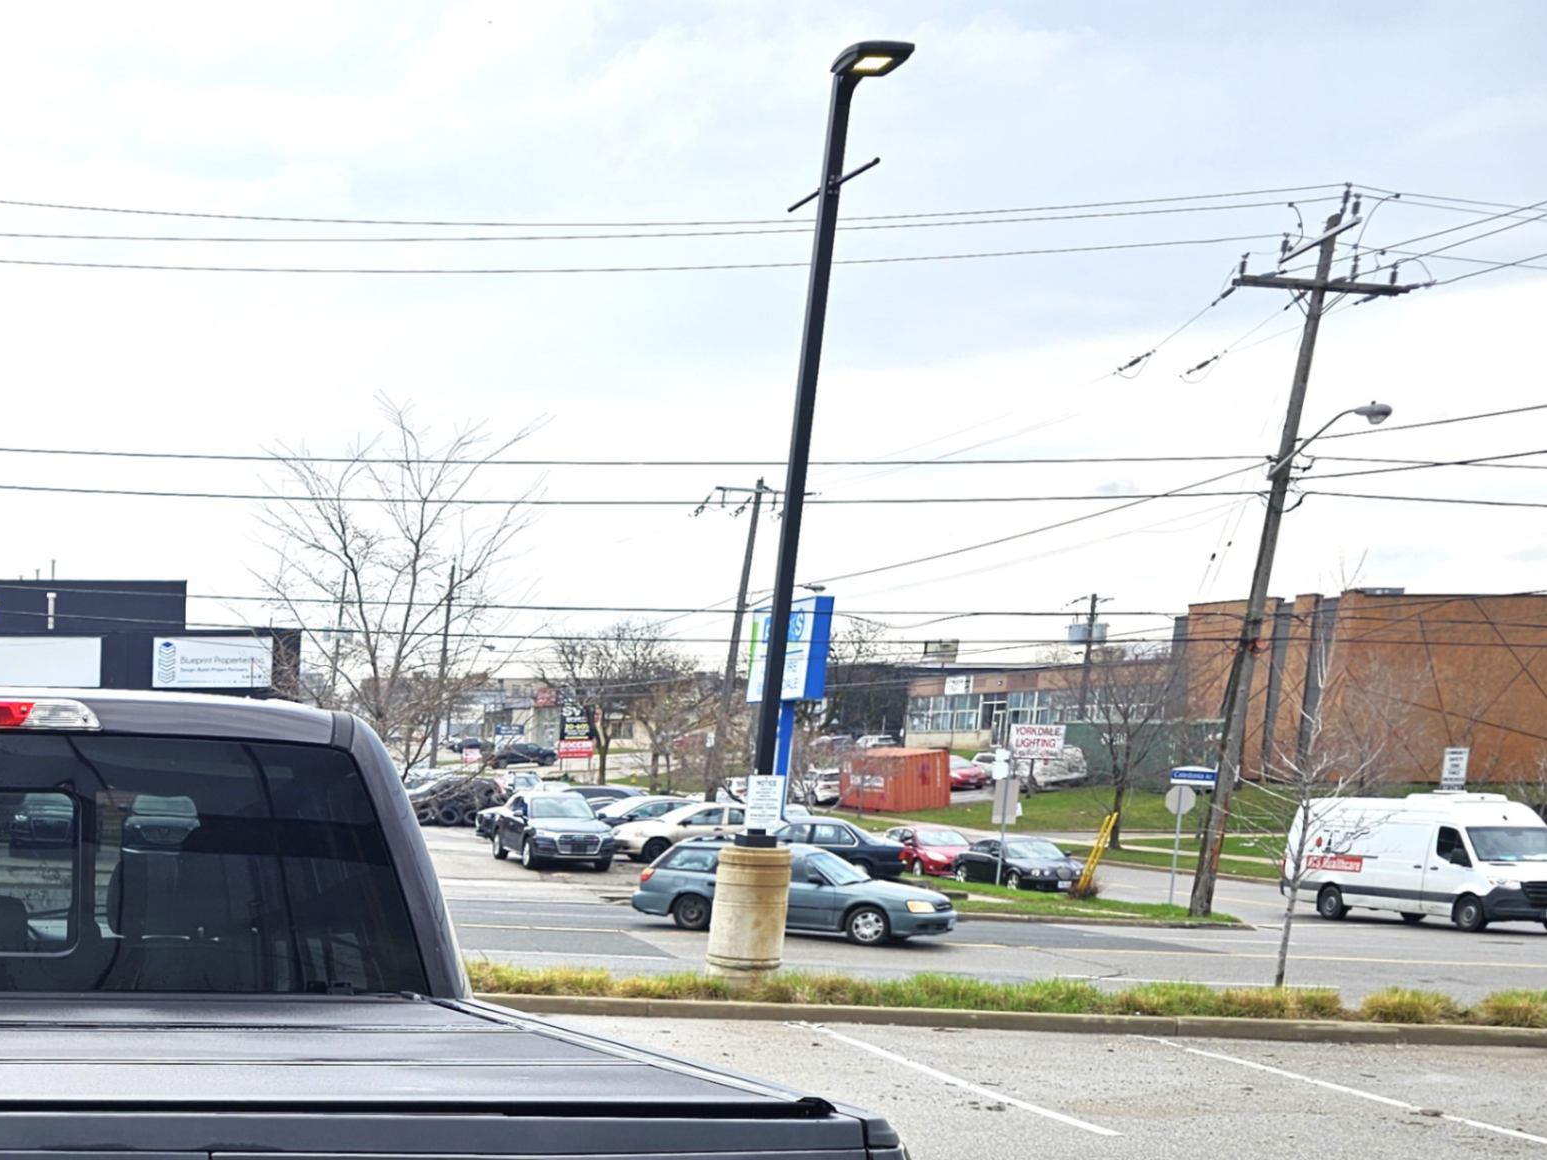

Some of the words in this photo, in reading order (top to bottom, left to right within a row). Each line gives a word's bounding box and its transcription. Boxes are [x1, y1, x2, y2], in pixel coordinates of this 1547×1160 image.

[180, 656, 212, 665] Blueprint
[1015, 726, 1062, 736] YORKDALE
[1015, 738, 1056, 748] LIGHTING
